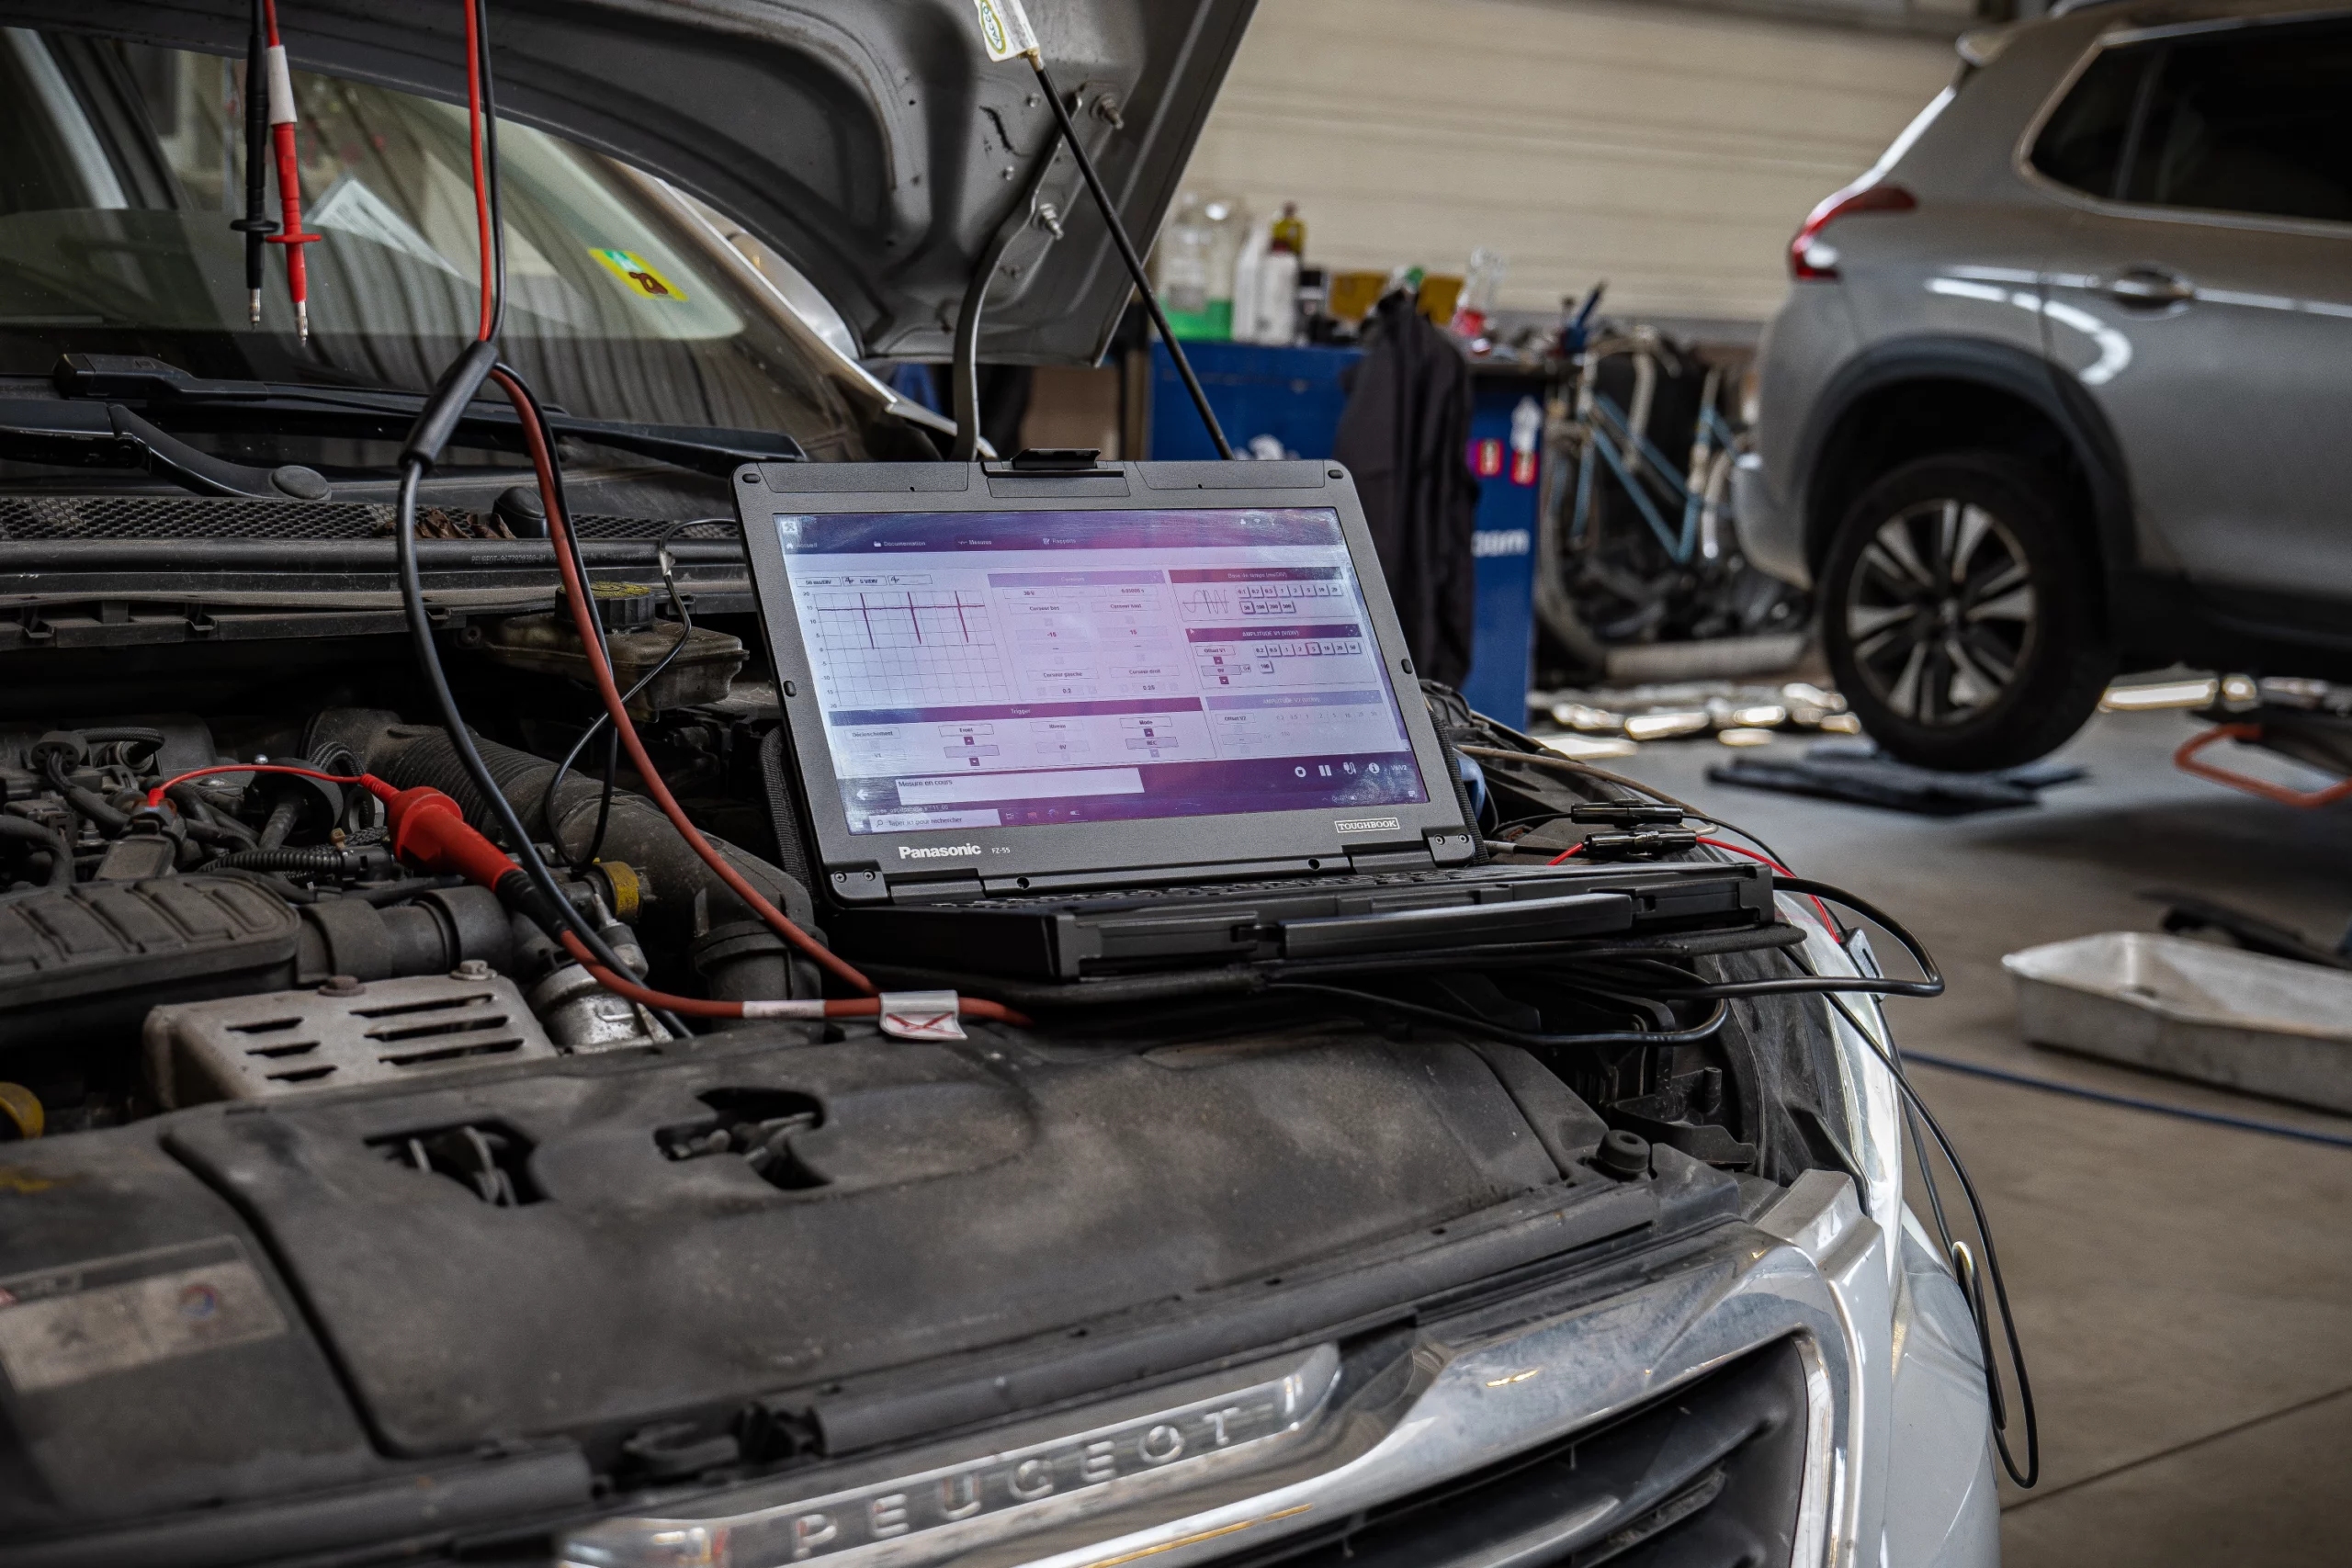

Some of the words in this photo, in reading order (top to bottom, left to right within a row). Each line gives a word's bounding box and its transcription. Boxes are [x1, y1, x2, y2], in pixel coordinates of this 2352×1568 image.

[1337, 818, 1397, 830] TOUGHBOOK
[898, 842, 982, 860] Panasonic
[792, 1405, 1240, 1562] PEUGEOT
